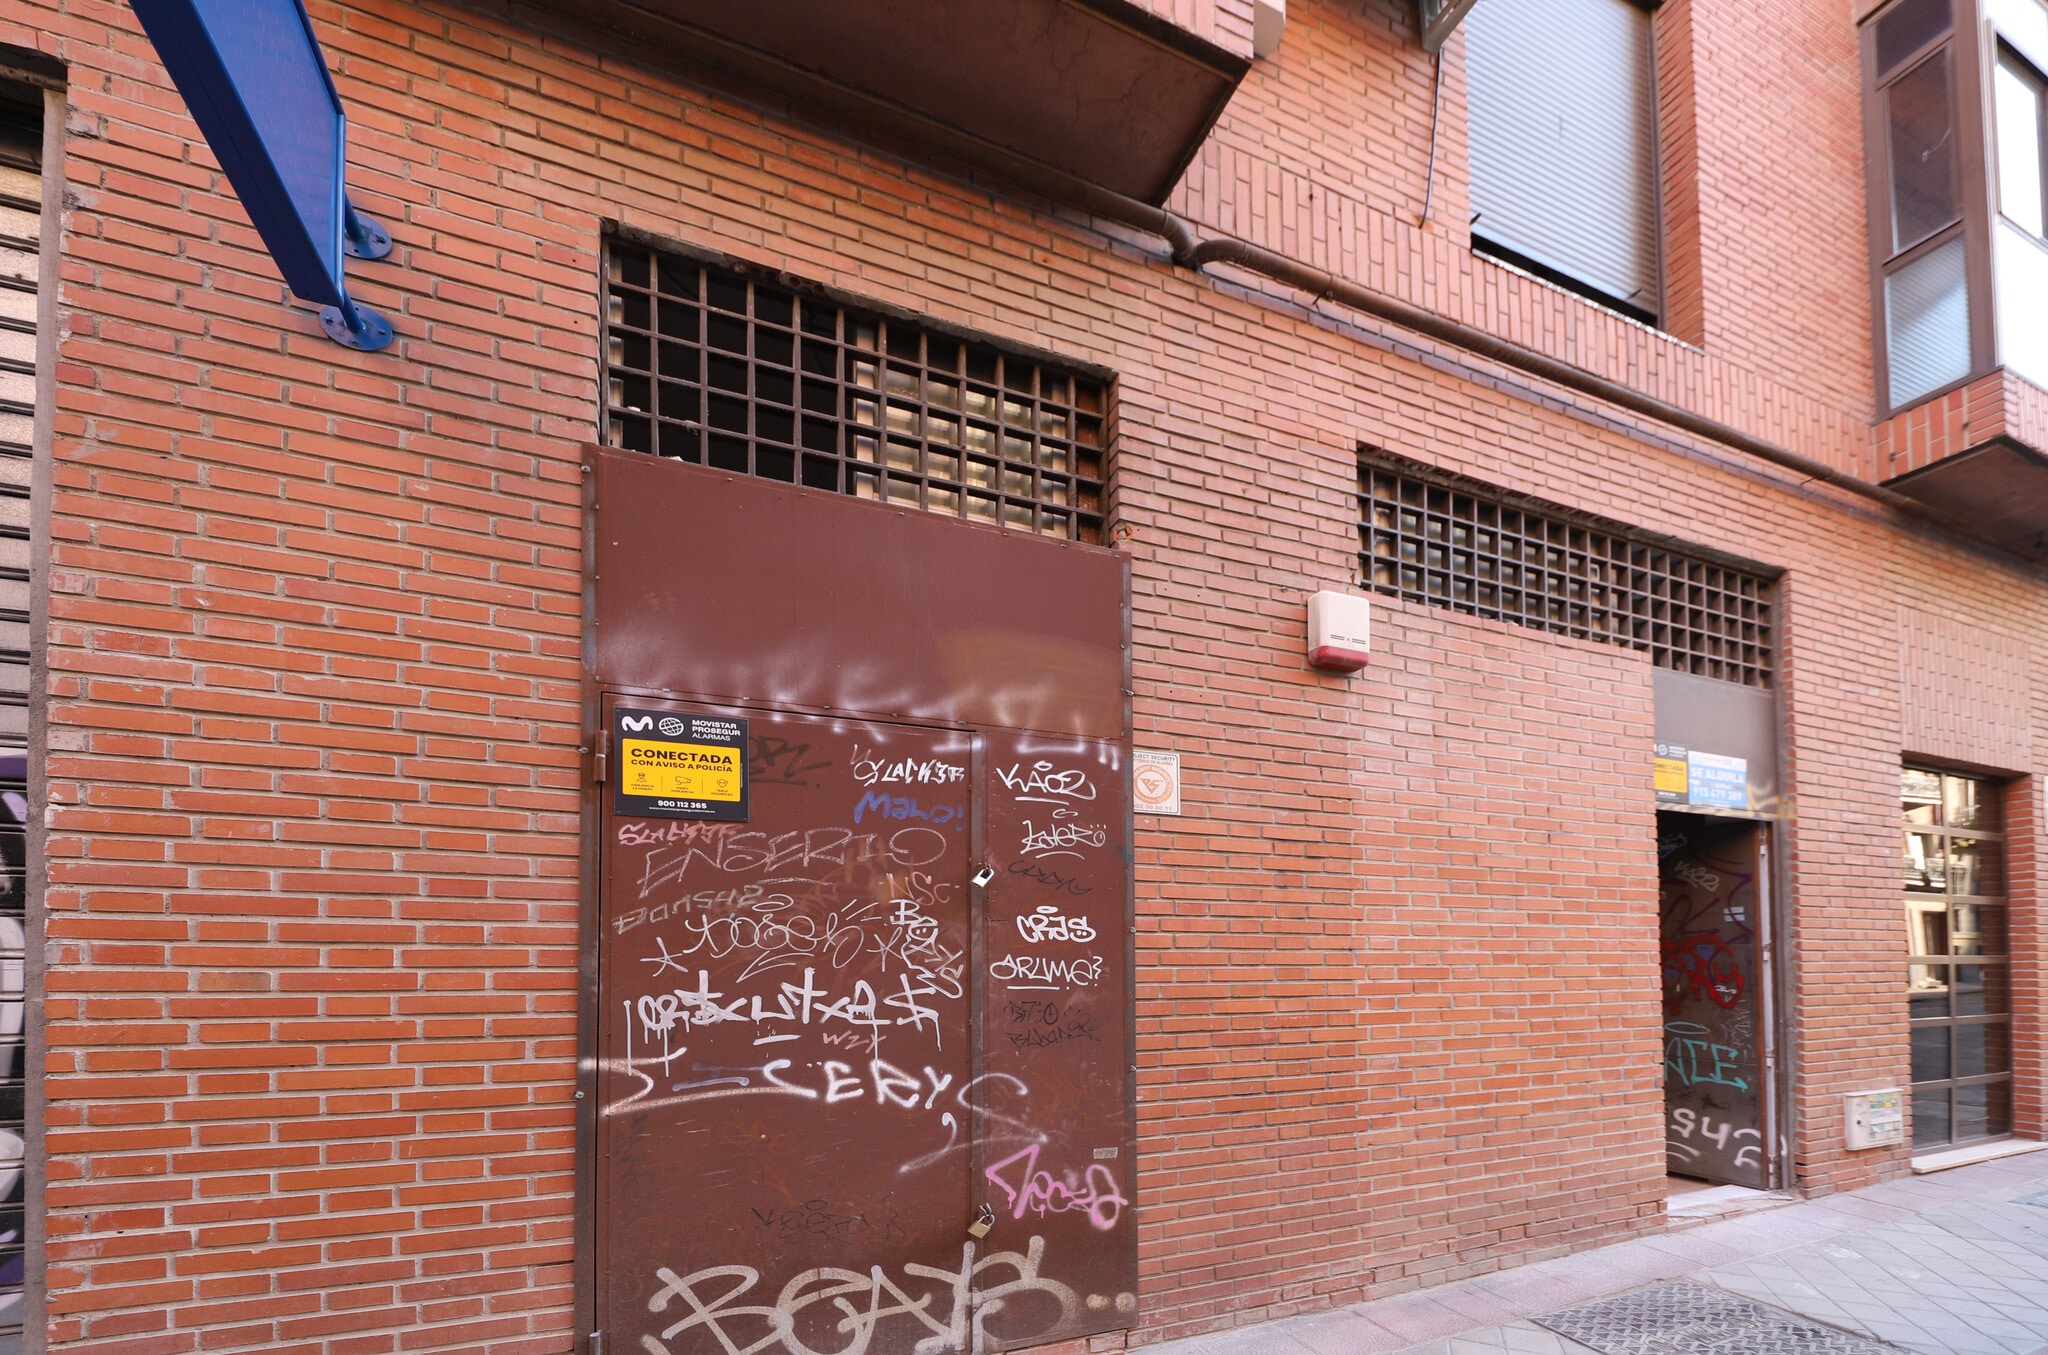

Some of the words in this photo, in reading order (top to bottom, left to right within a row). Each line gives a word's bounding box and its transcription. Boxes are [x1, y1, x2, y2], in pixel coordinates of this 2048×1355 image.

[692, 720, 737, 730] MOVISTAR
[692, 726, 741, 737] PROSEGUR
[692, 733, 731, 742] ALARMAS
[631, 748, 733, 765] CONECTADA
[655, 761, 686, 769] AVISO
[696, 764, 733, 773] POLICÍA
[1690, 767, 1704, 778] SE
[1705, 769, 1745, 783] ALQUILA
